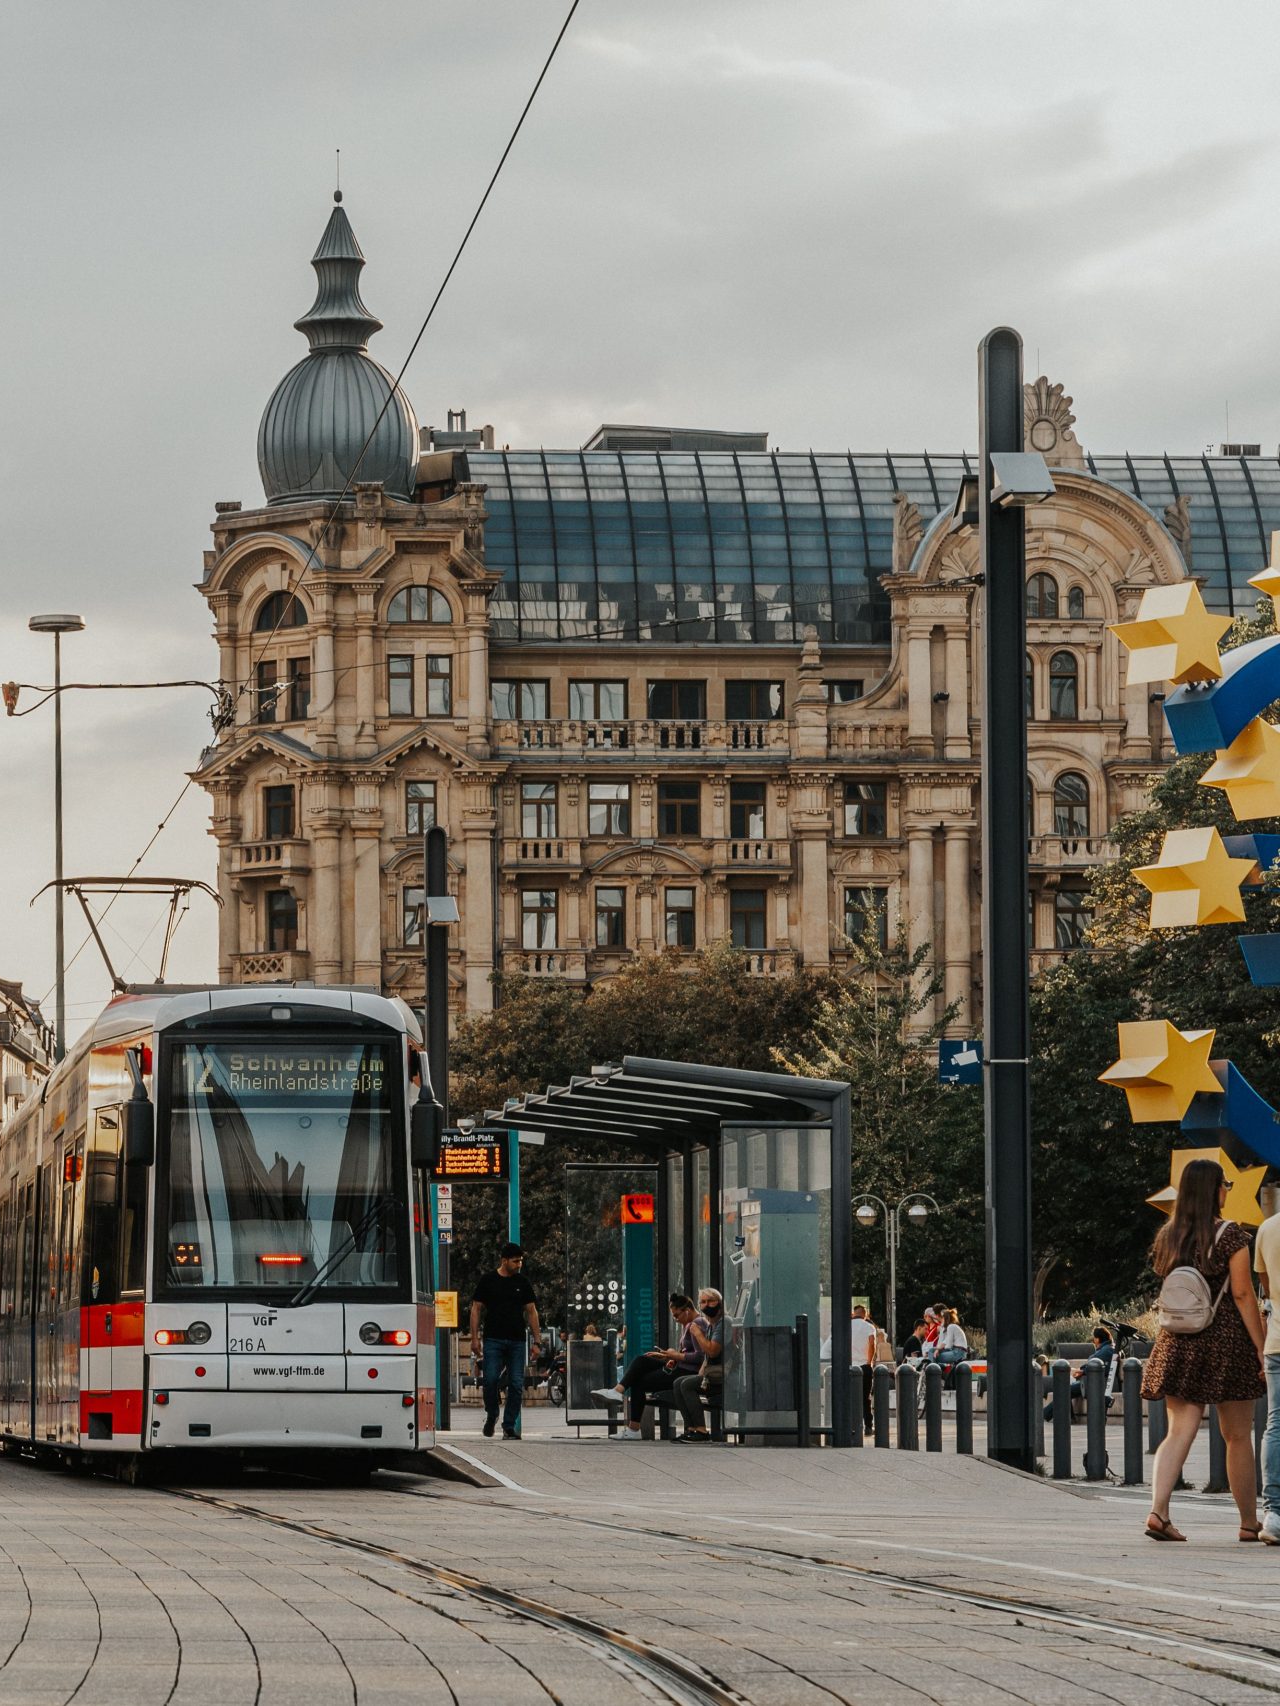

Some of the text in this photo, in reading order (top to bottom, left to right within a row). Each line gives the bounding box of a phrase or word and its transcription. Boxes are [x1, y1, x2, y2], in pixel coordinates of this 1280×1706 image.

[230, 1054, 385, 1072] Schwanheim
[182, 1054, 214, 1093] 12
[230, 1073, 384, 1094] Rheinlandstraße
[441, 1134, 495, 1144] illy-Brandt-Platz
[230, 1338, 266, 1352] 216 A
[253, 1366, 325, 1378] www.vgf-ffm.de
